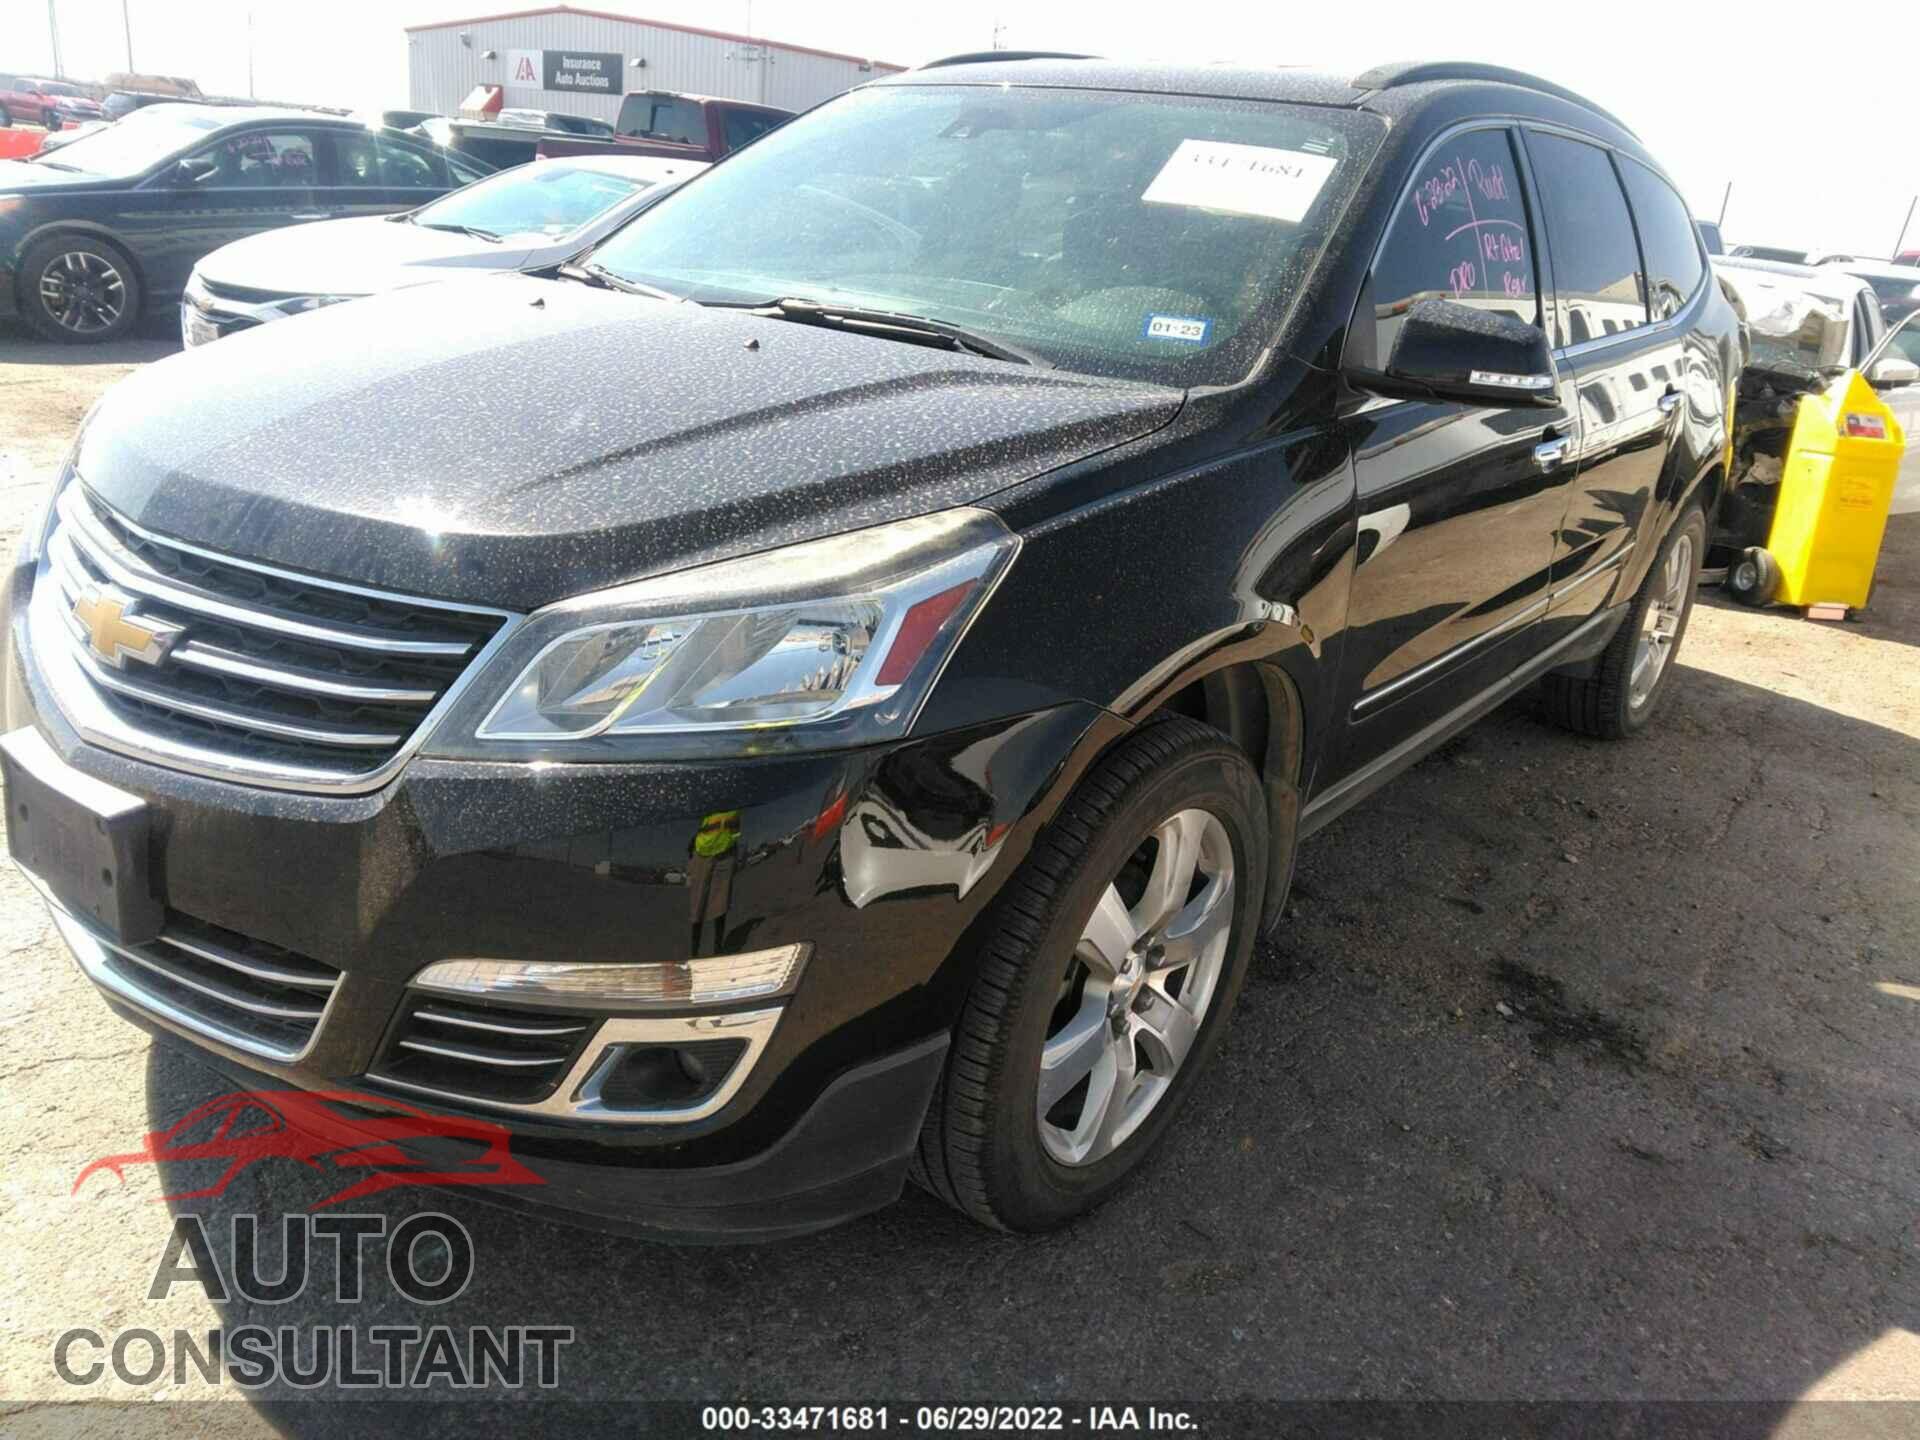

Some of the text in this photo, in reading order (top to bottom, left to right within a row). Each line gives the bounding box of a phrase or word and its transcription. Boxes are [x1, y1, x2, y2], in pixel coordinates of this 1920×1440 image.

[562, 55, 602, 71] Insurance
[555, 71, 609, 88] Auto Auctions
